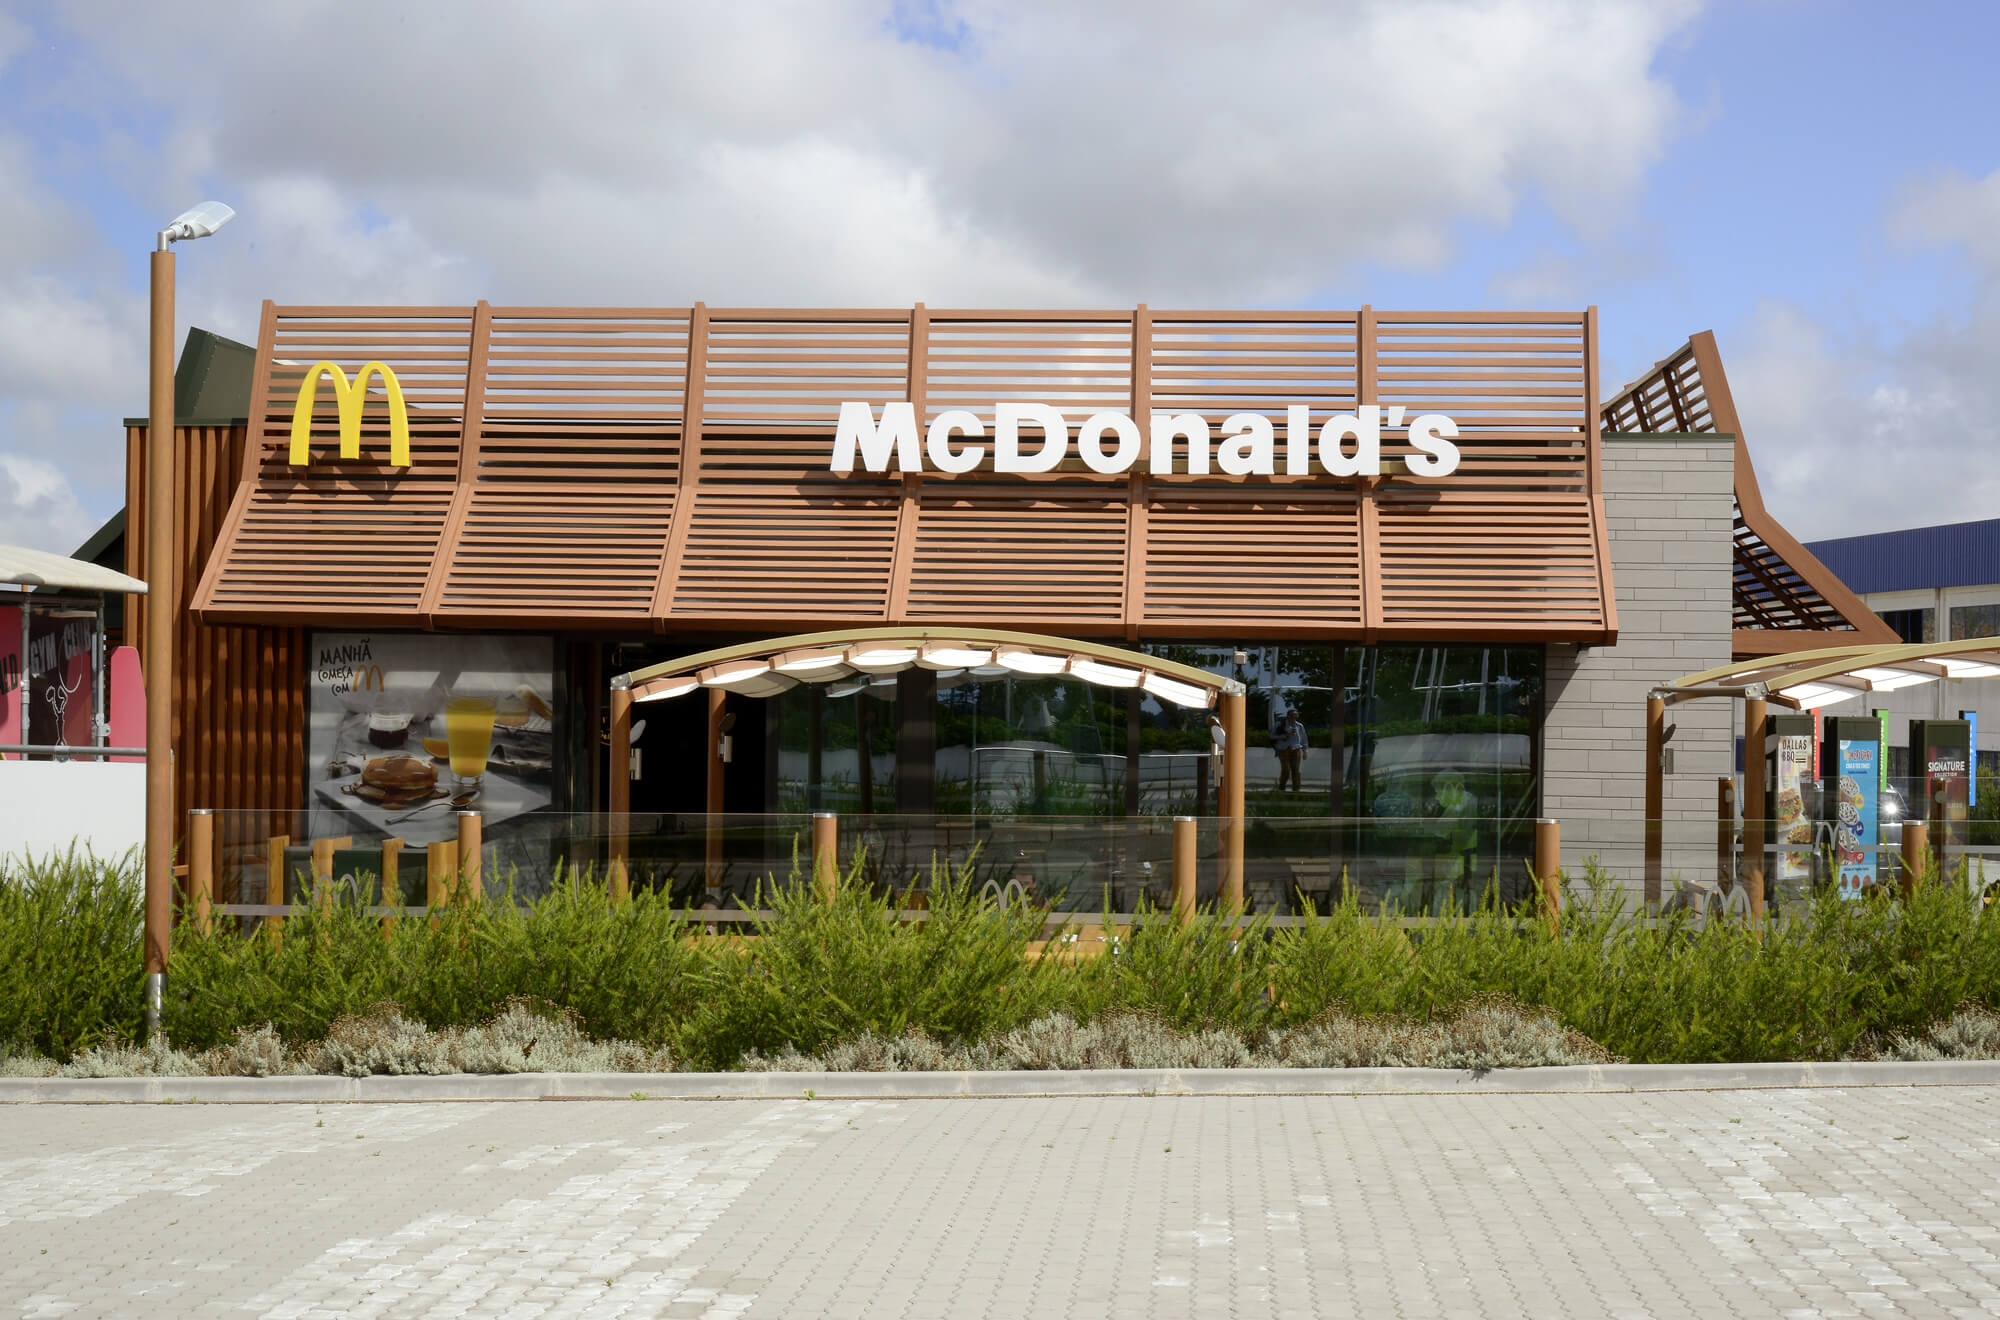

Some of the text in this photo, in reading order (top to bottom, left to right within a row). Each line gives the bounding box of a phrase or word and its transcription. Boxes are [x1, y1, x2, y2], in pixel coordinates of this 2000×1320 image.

[830, 402, 1461, 477] McDonald's
[30, 632, 57, 678] GYM
[320, 637, 372, 666] MANHÃ
[318, 665, 353, 683] COMEÇA
[331, 683, 350, 697] COM
[1782, 739, 1807, 750] DALLAS
[1782, 751, 1795, 763] BBQ
[1928, 761, 1965, 772] SIGNATURE
